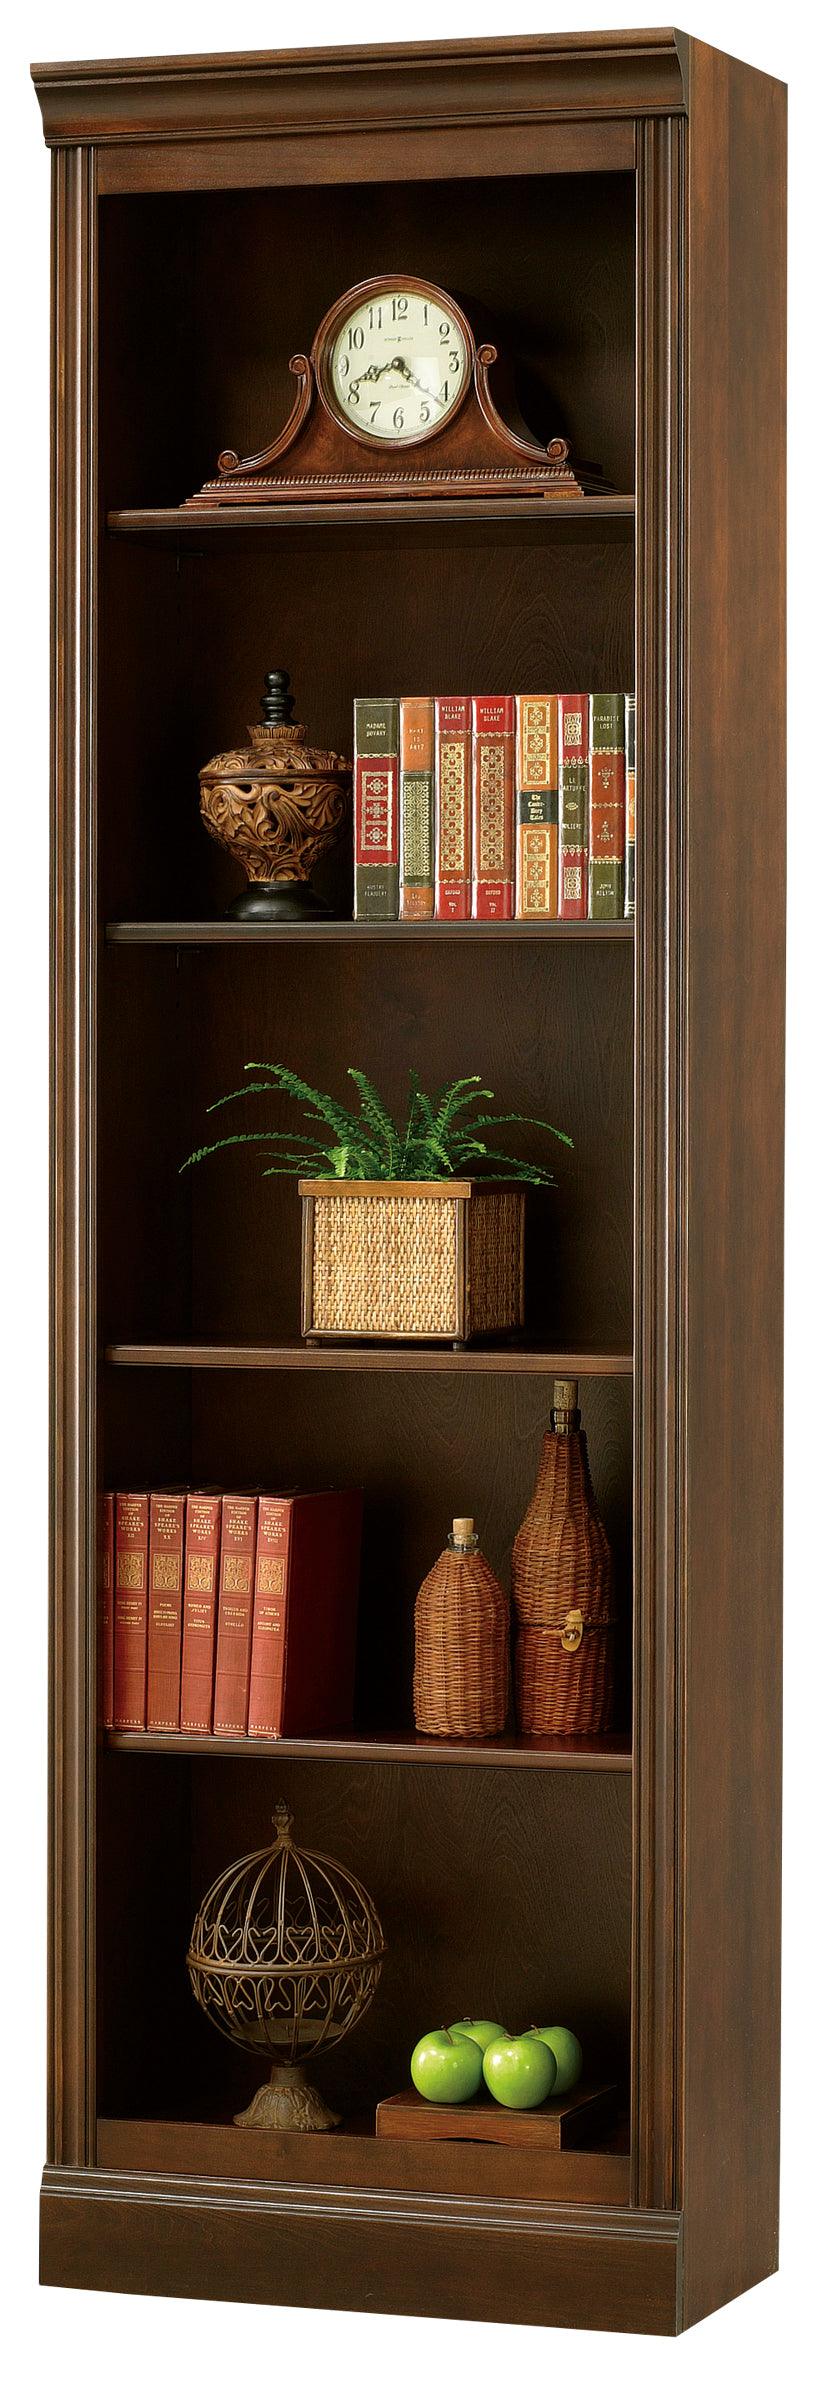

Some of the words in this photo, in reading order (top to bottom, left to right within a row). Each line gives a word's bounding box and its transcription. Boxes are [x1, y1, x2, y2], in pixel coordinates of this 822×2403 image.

[369, 307, 382, 329] 11
[392, 298, 408, 321] 12
[423, 304, 428, 326] 1
[348, 327, 364, 350] 10
[439, 323, 450, 345] 2
[338, 355, 349, 377] 9
[449, 351, 459, 373] 3
[347, 380, 360, 404] 8
[439, 380, 450, 402] 4
[369, 401, 381, 424] 7
[393, 407, 404, 429] 6
[419, 401, 430, 422] 5
